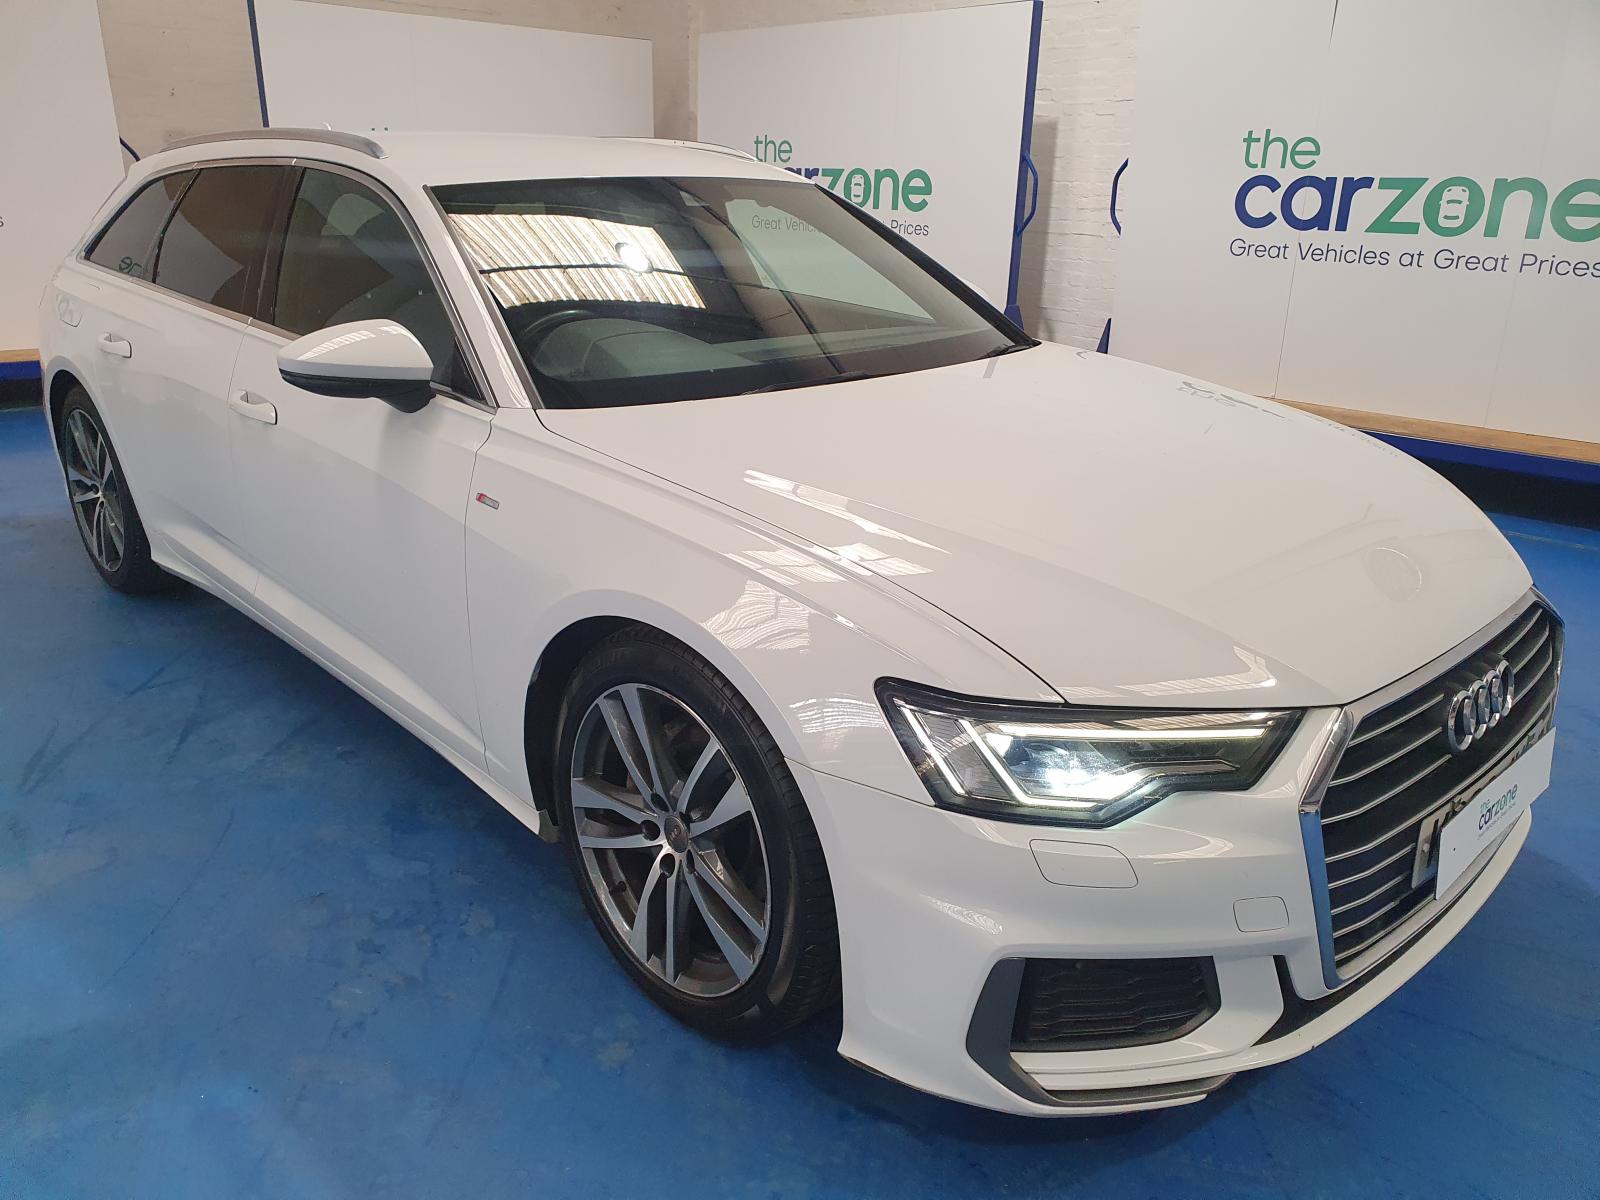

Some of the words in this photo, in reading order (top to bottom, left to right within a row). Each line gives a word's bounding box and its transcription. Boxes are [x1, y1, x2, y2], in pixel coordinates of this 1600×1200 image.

[754, 134, 793, 163] the
[1243, 129, 1321, 169] the
[751, 214, 781, 231] Great
[890, 219, 930, 236] Prices
[1234, 174, 1600, 243] carzone
[1229, 238, 1289, 260] Great
[1298, 242, 1390, 266] Vehicles
[1398, 250, 1425, 268] at
[1433, 248, 1509, 273] Great
[1478, 783, 1518, 831] carzone
